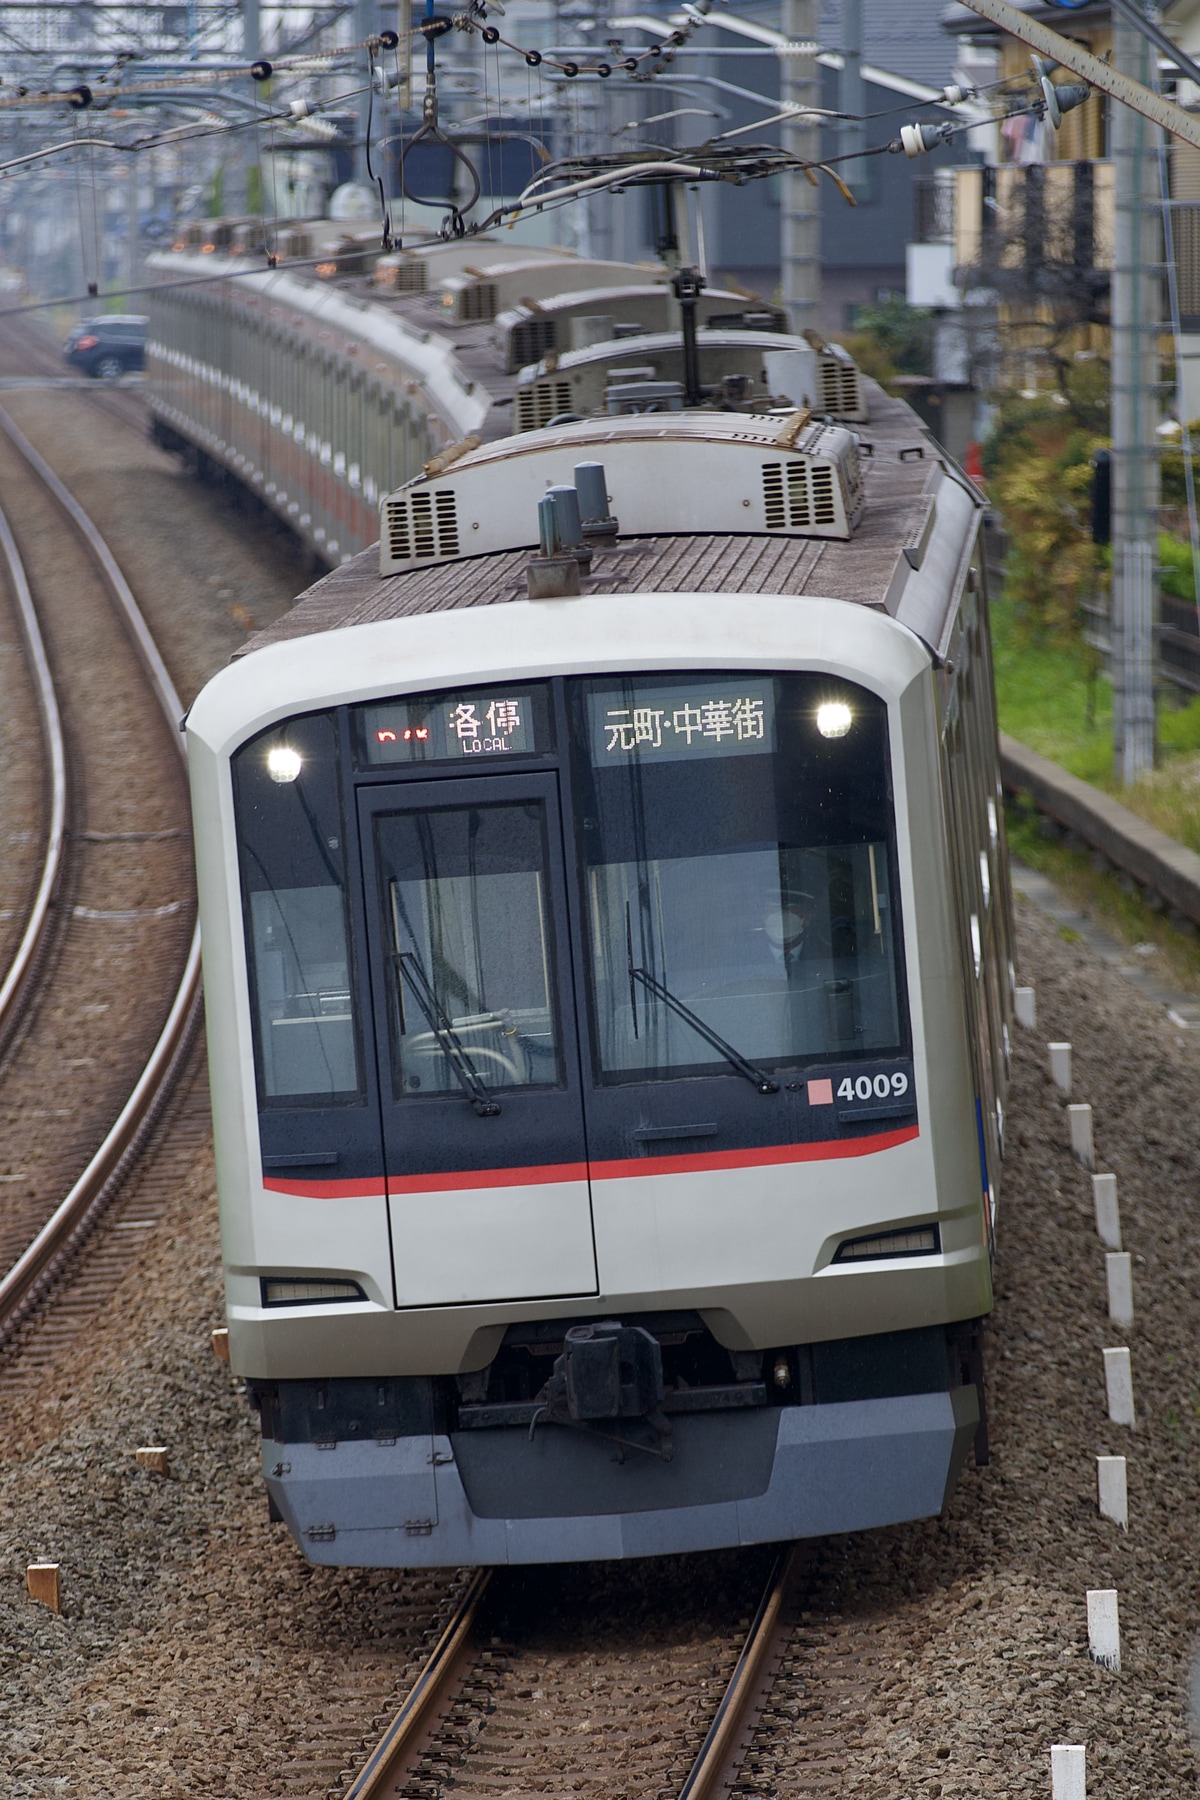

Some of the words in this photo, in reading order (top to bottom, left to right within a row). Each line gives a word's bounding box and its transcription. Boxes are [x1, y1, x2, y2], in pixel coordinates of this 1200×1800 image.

[450, 700, 521, 738] 各停
[462, 738, 512, 753] LOCAL
[836, 1072, 908, 1101] 4009
